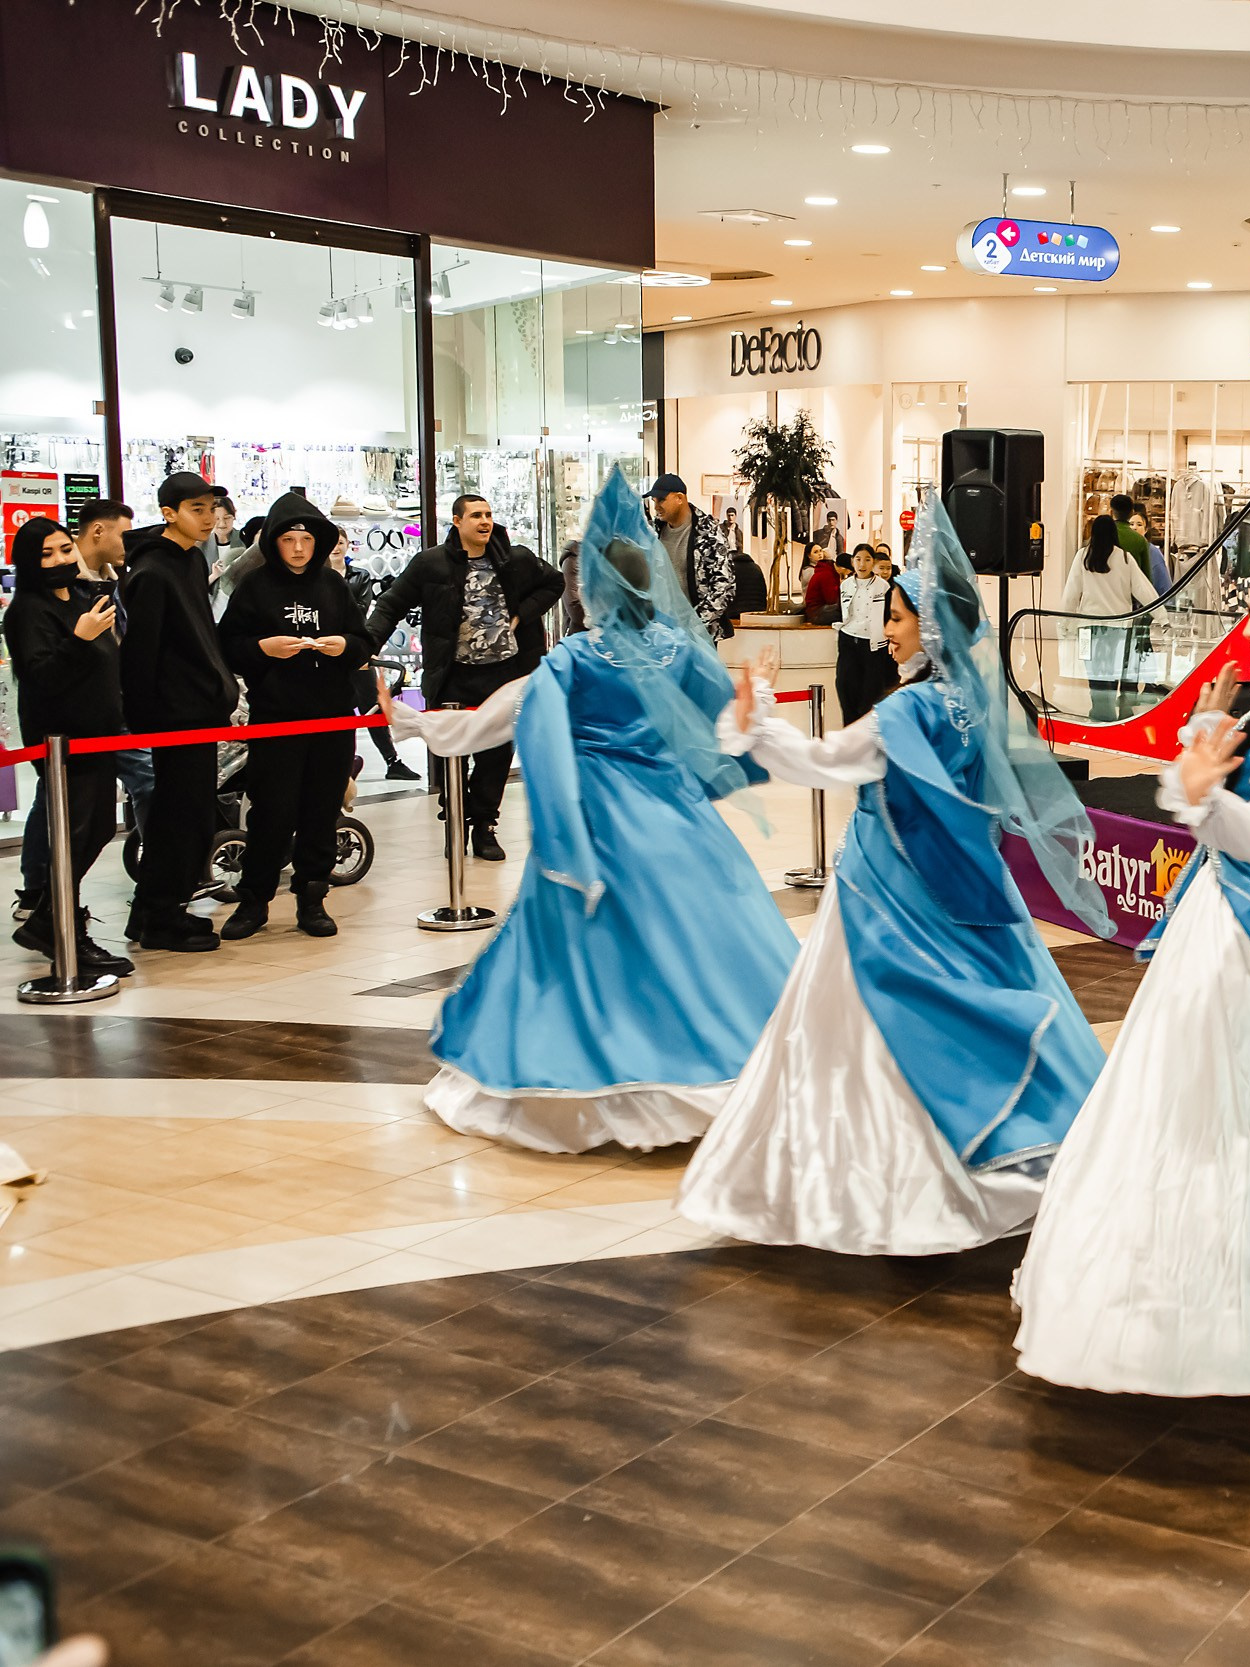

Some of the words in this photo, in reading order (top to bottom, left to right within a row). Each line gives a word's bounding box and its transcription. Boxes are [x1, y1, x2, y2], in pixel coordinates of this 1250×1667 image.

[180, 51, 367, 140] LADY
[177, 120, 350, 163] COLLECTION
[986, 239, 998, 259] 2
[1019, 247, 1075, 266] Детский
[1077, 255, 1106, 272] мир
[730, 319, 822, 377] DeFacto
[1078, 839, 1152, 907] Batyr
[1138, 898, 1166, 921] ma
